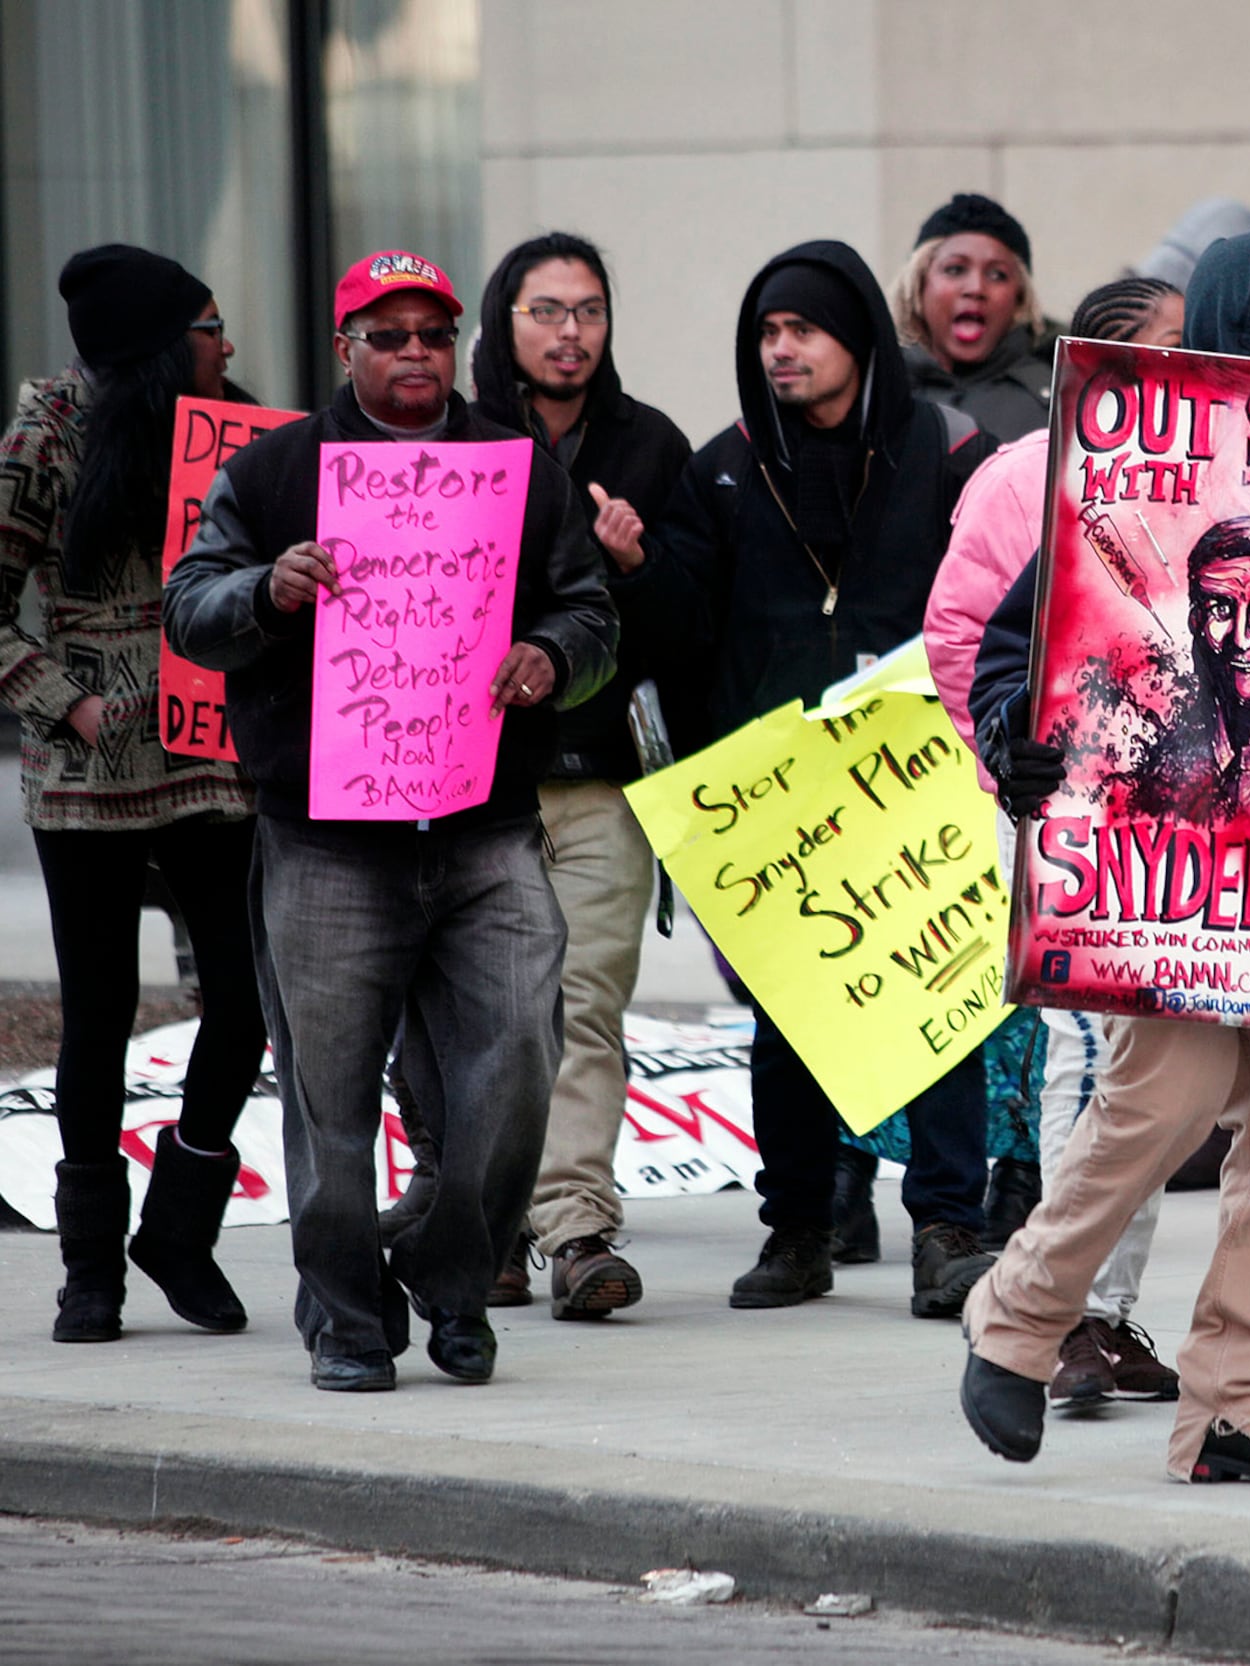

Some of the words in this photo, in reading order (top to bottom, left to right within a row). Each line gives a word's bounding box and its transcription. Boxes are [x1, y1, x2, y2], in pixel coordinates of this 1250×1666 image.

[1076, 370, 1232, 461] OUT
[326, 450, 508, 507] Restore
[1080, 450, 1201, 506] WITH
[385, 501, 440, 531] the
[320, 537, 507, 582] Democratic
[322, 584, 455, 649] Rights
[328, 634, 471, 693] Detroit
[337, 694, 472, 751] People
[714, 805, 846, 917] Snyder
[847, 734, 963, 812] Plan,
[799, 823, 973, 959] Strike
[1060, 927, 1131, 948] STRIKE
[1152, 931, 1188, 947] WIN
[846, 972, 883, 1008] to
